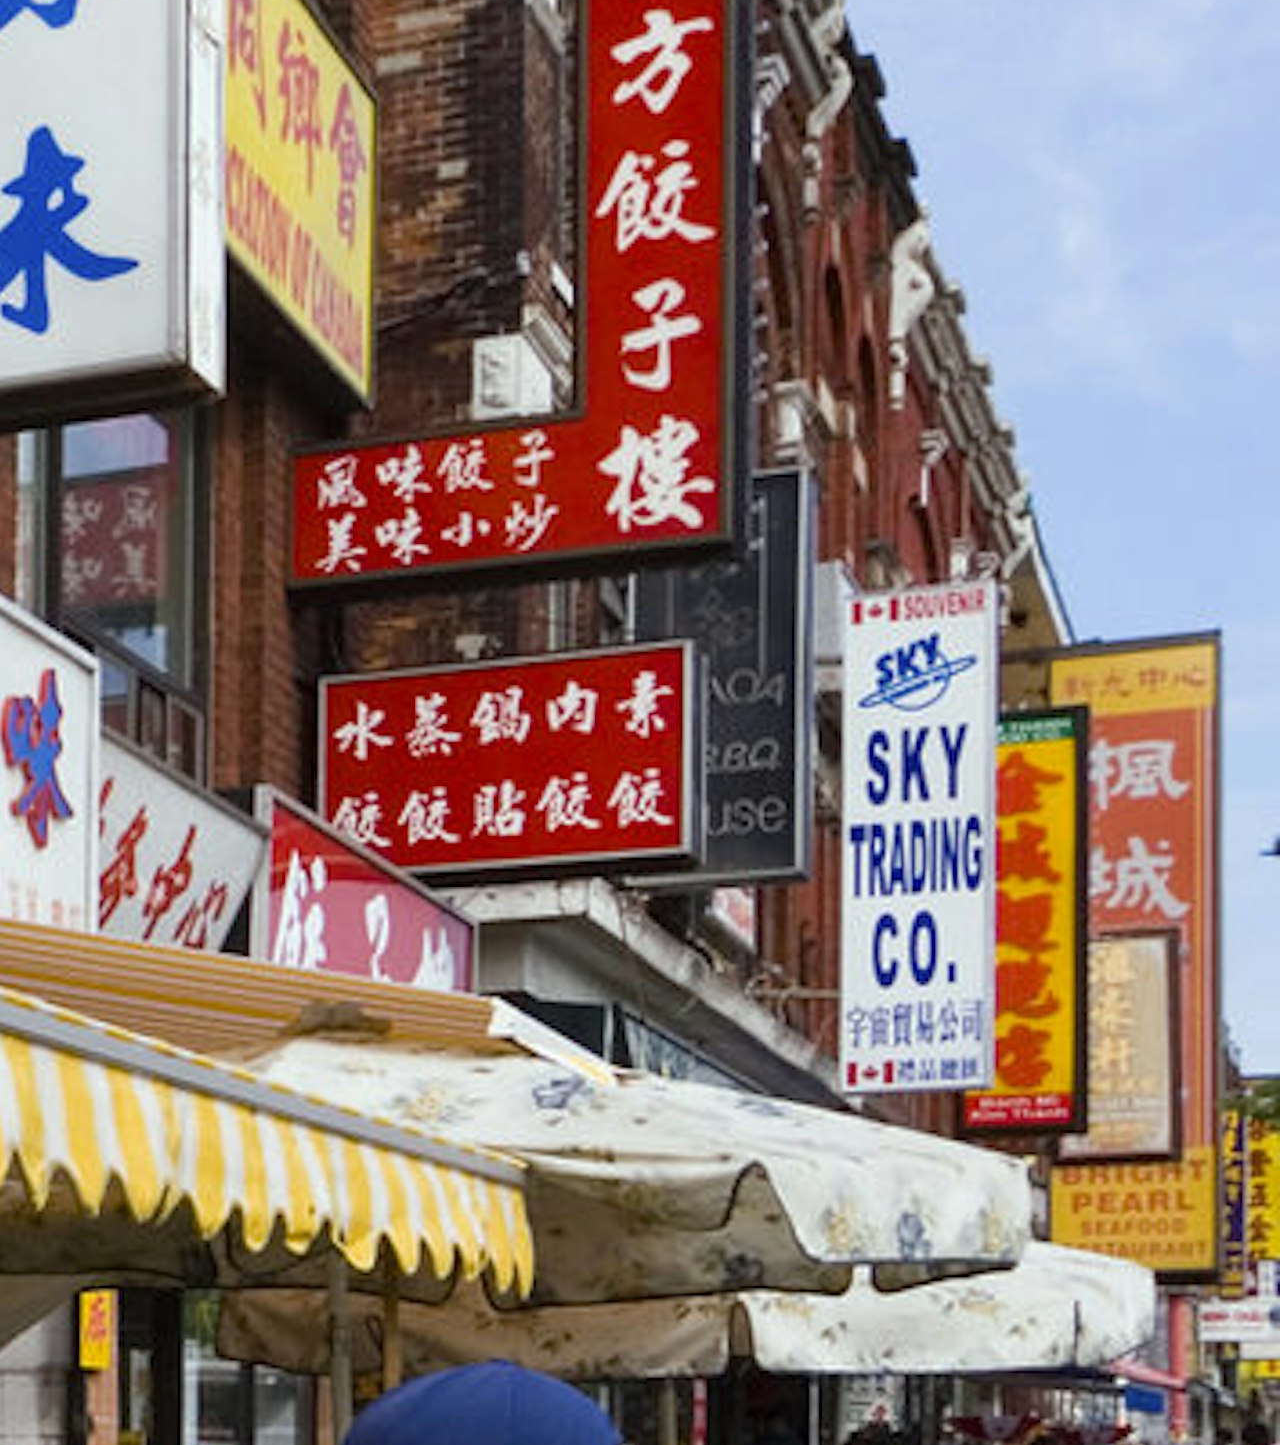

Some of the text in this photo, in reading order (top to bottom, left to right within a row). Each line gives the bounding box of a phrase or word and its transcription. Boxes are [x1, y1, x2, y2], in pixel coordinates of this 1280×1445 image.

[316, 428, 557, 512] 風味餃子
[314, 492, 561, 574] 美味小炒
[903, 589, 986, 621] SOUVENIR
[875, 633, 940, 689] SKY
[866, 723, 967, 805] SKY
[849, 814, 983, 898] TRADING
[872, 910, 957, 988] CO.
[1071, 1188, 1195, 1215] PEARL
[1080, 1216, 1189, 1237] SEAFOOD
